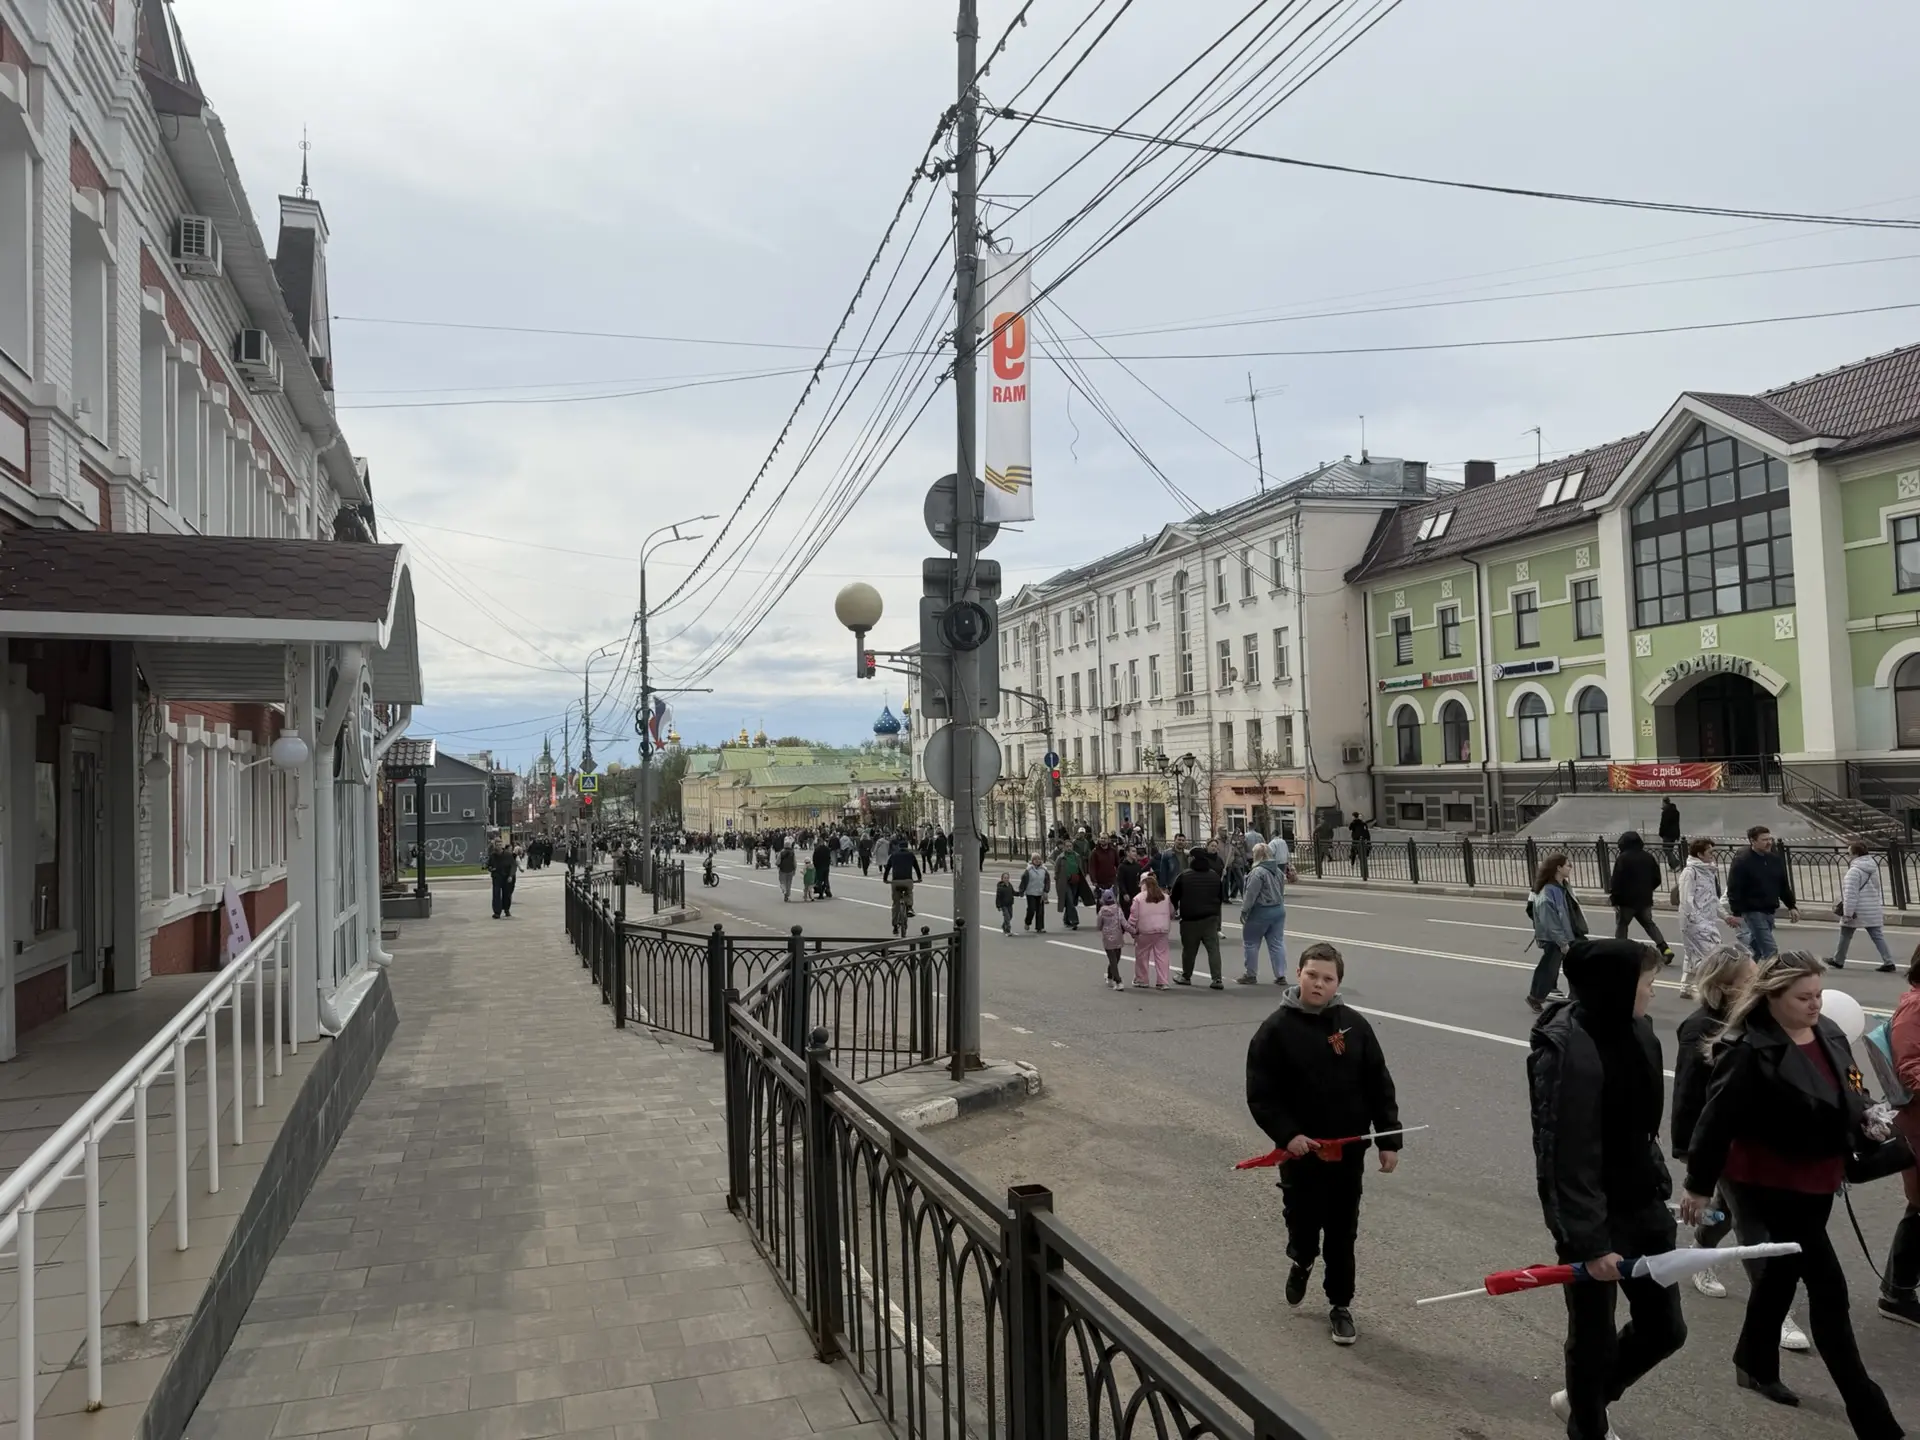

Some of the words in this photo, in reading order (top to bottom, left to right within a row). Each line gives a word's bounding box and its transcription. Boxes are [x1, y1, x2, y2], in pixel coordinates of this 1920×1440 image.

[1665, 653, 1753, 682] ЗОДИАК
[1652, 768, 1658, 776] С
[1660, 766, 1682, 777] ДНЁМ
[1636, 778, 1666, 788] ВЕЛИКОЙ
